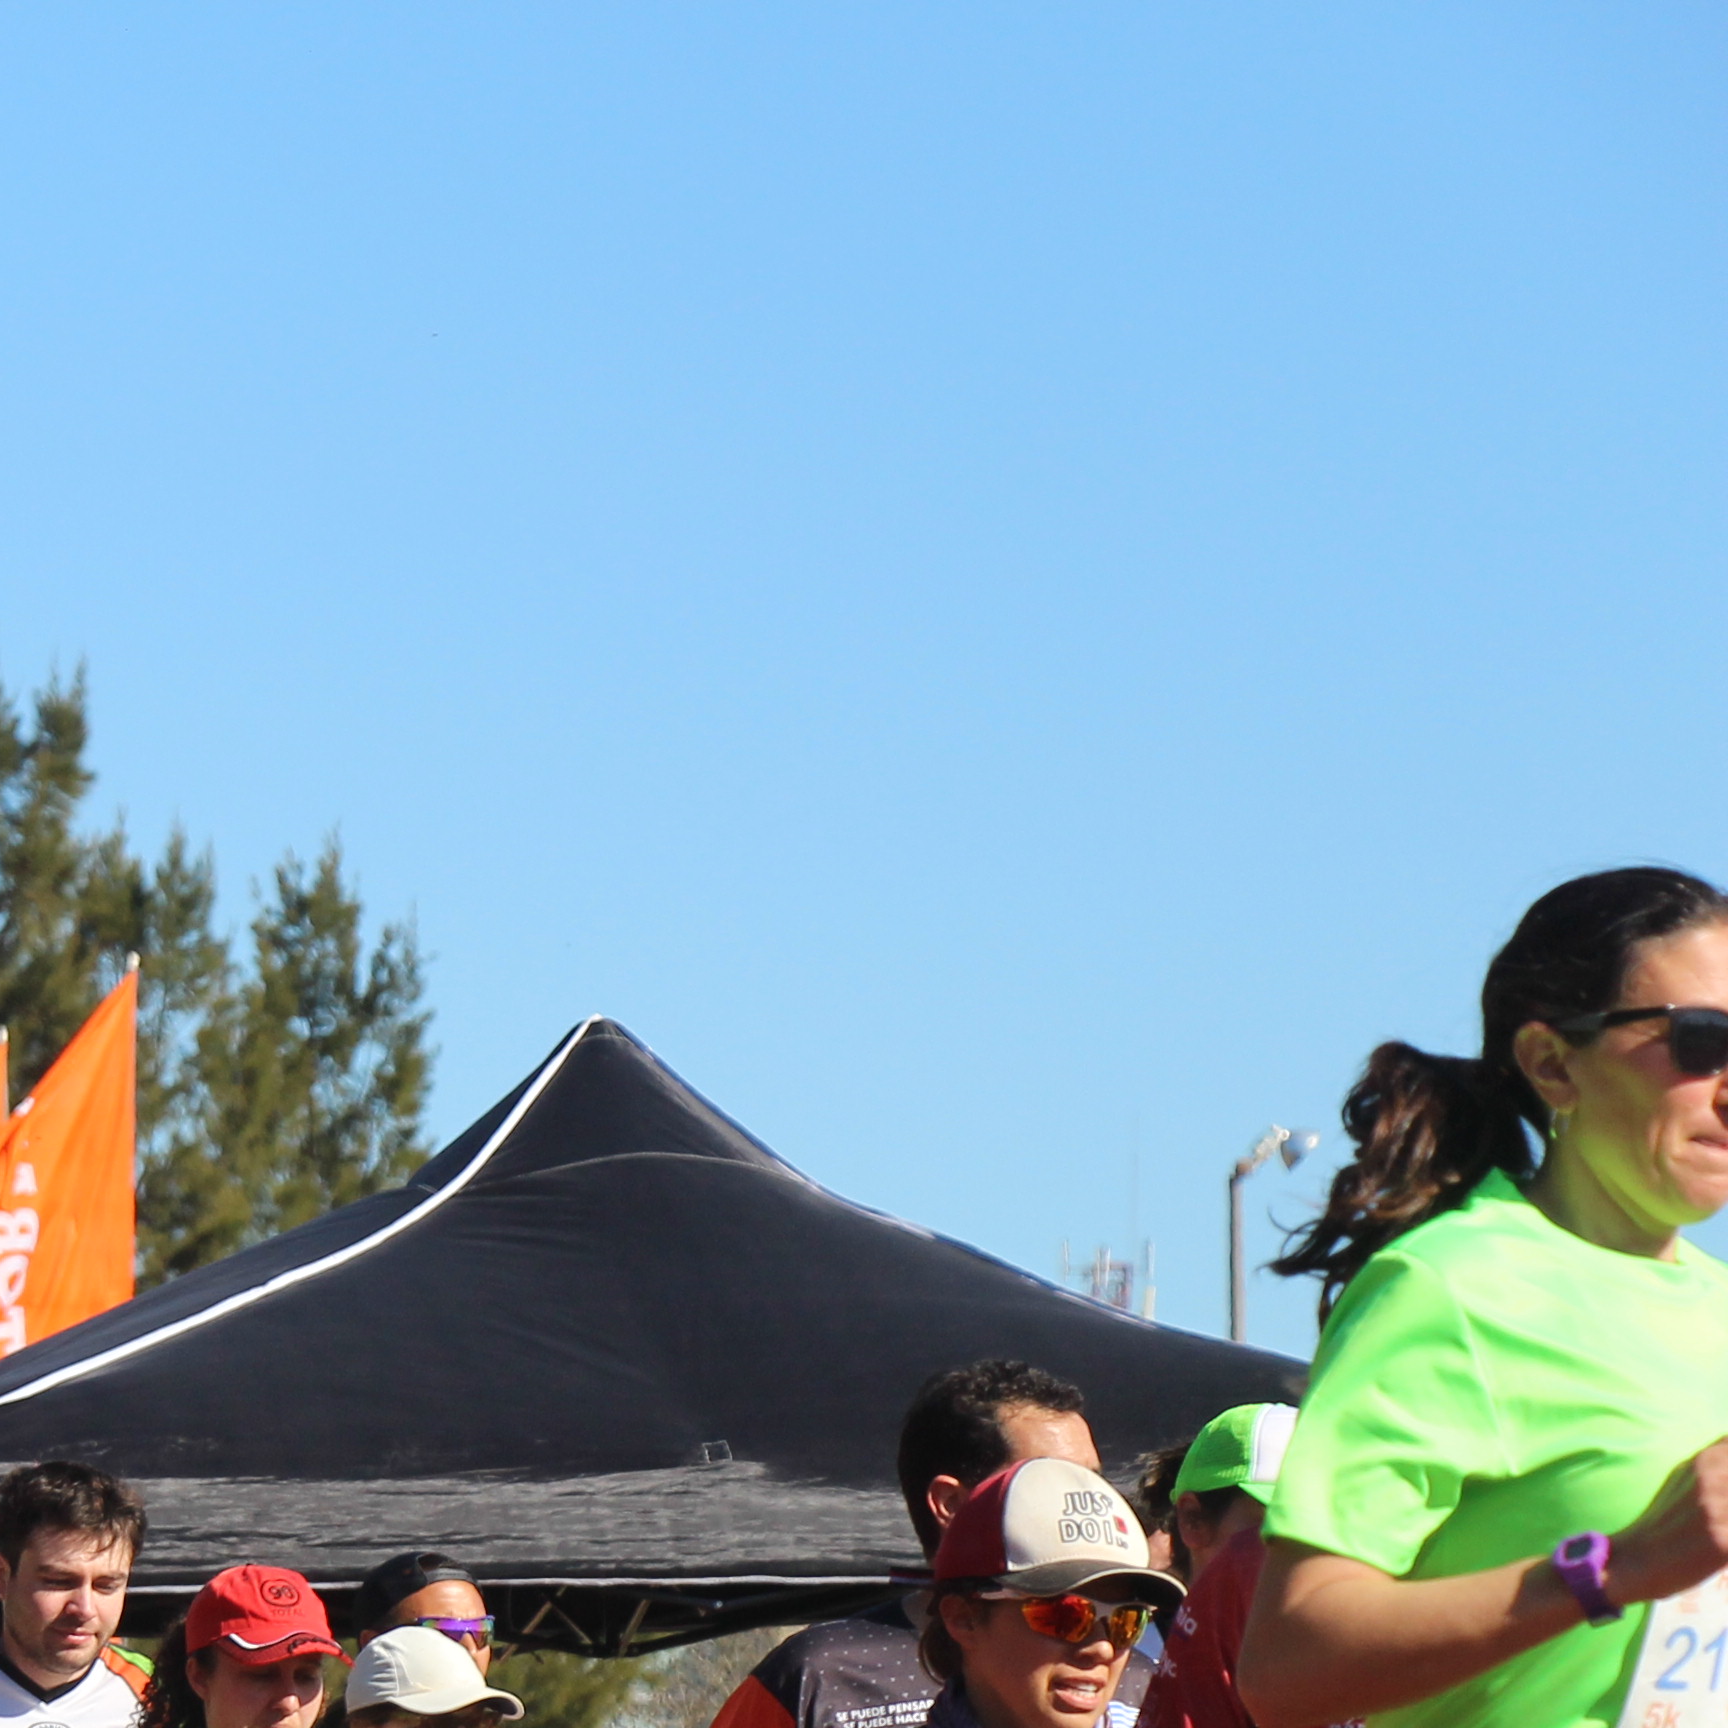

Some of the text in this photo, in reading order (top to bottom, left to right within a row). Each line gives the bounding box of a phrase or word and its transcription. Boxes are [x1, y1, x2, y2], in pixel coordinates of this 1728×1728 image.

[836, 1711, 848, 1722] SE
[850, 1705, 886, 1720] PUEDE
[895, 1712, 927, 1724] HACE
